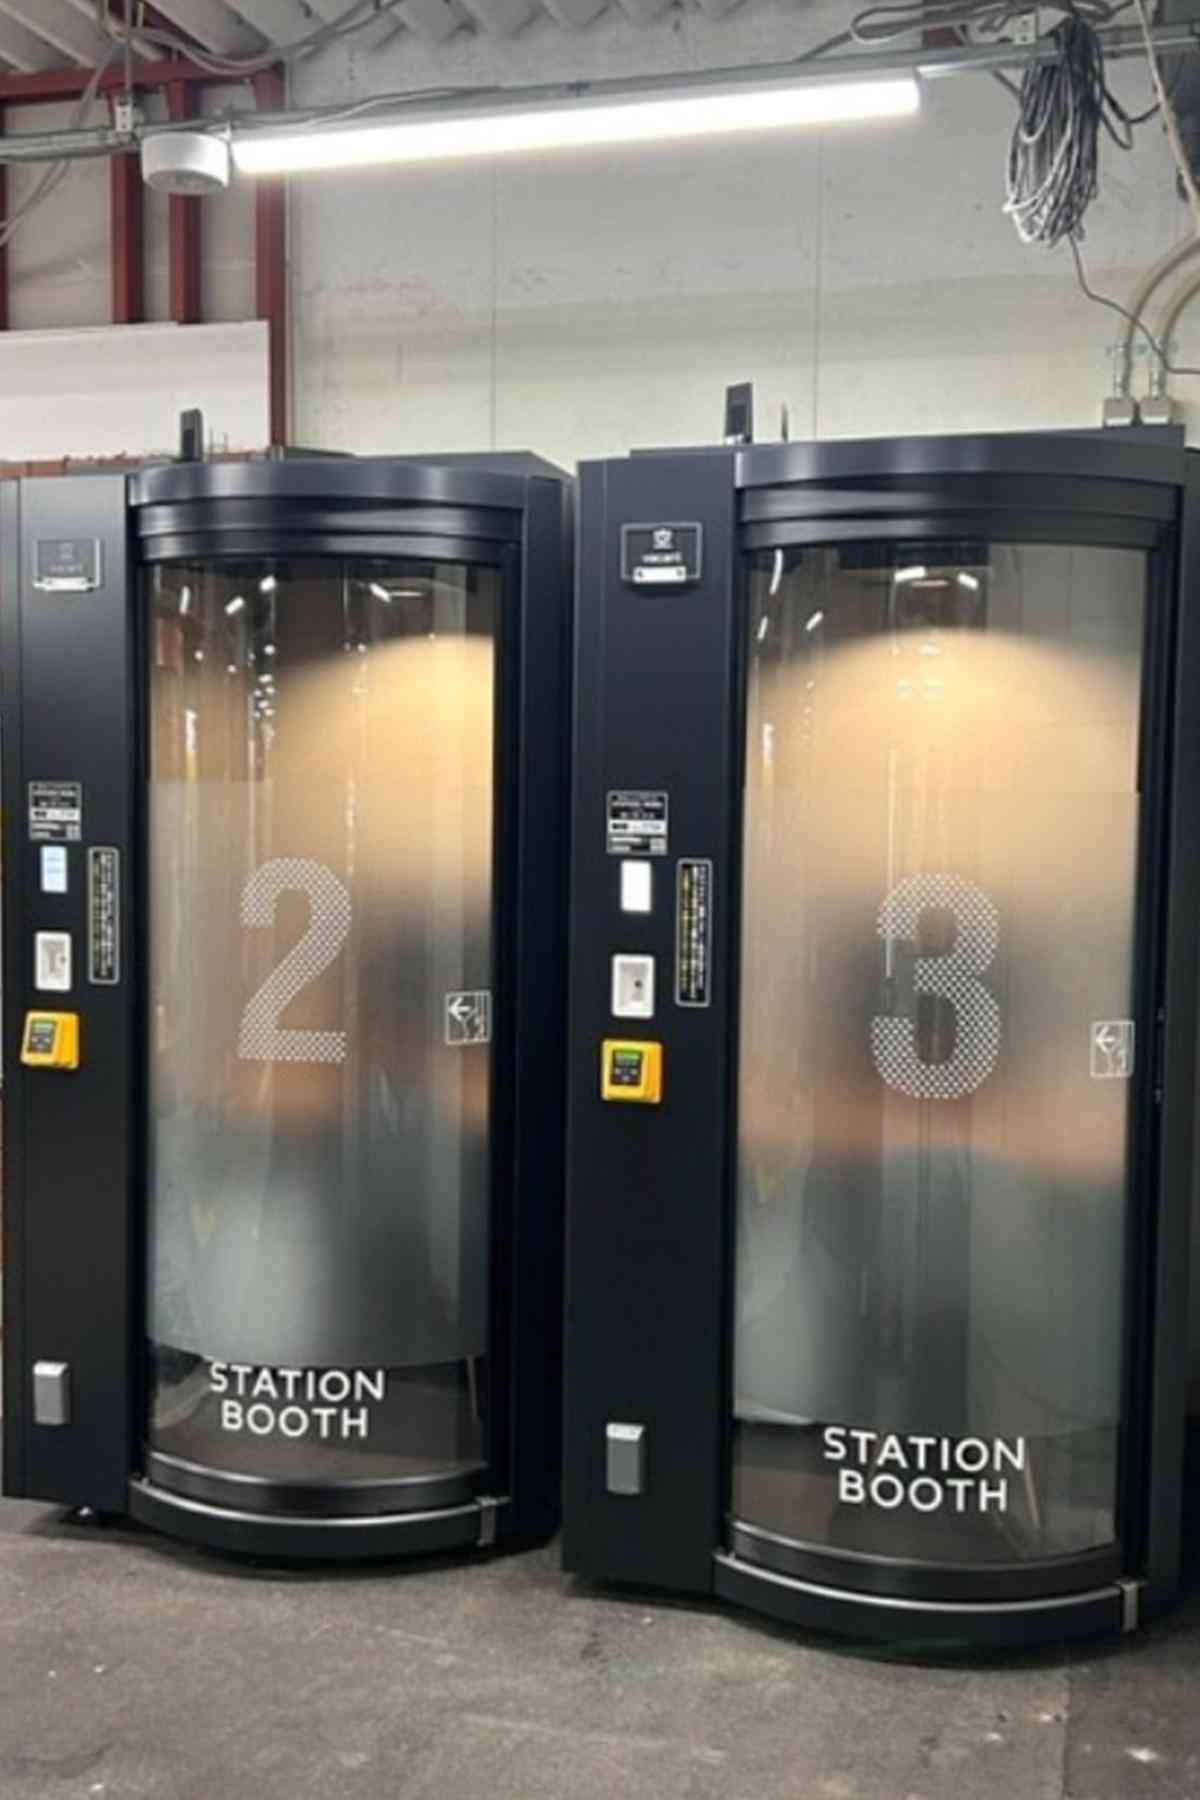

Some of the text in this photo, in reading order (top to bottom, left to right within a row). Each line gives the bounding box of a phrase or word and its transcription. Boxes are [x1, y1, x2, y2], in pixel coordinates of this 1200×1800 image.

[237, 856, 351, 1064] 2
[870, 873, 1000, 1099] 3
[209, 1360, 385, 1401] STATION
[222, 1399, 368, 1438] BOOTH
[823, 1426, 1025, 1472] STATION
[839, 1468, 1008, 1512] BOOTH
